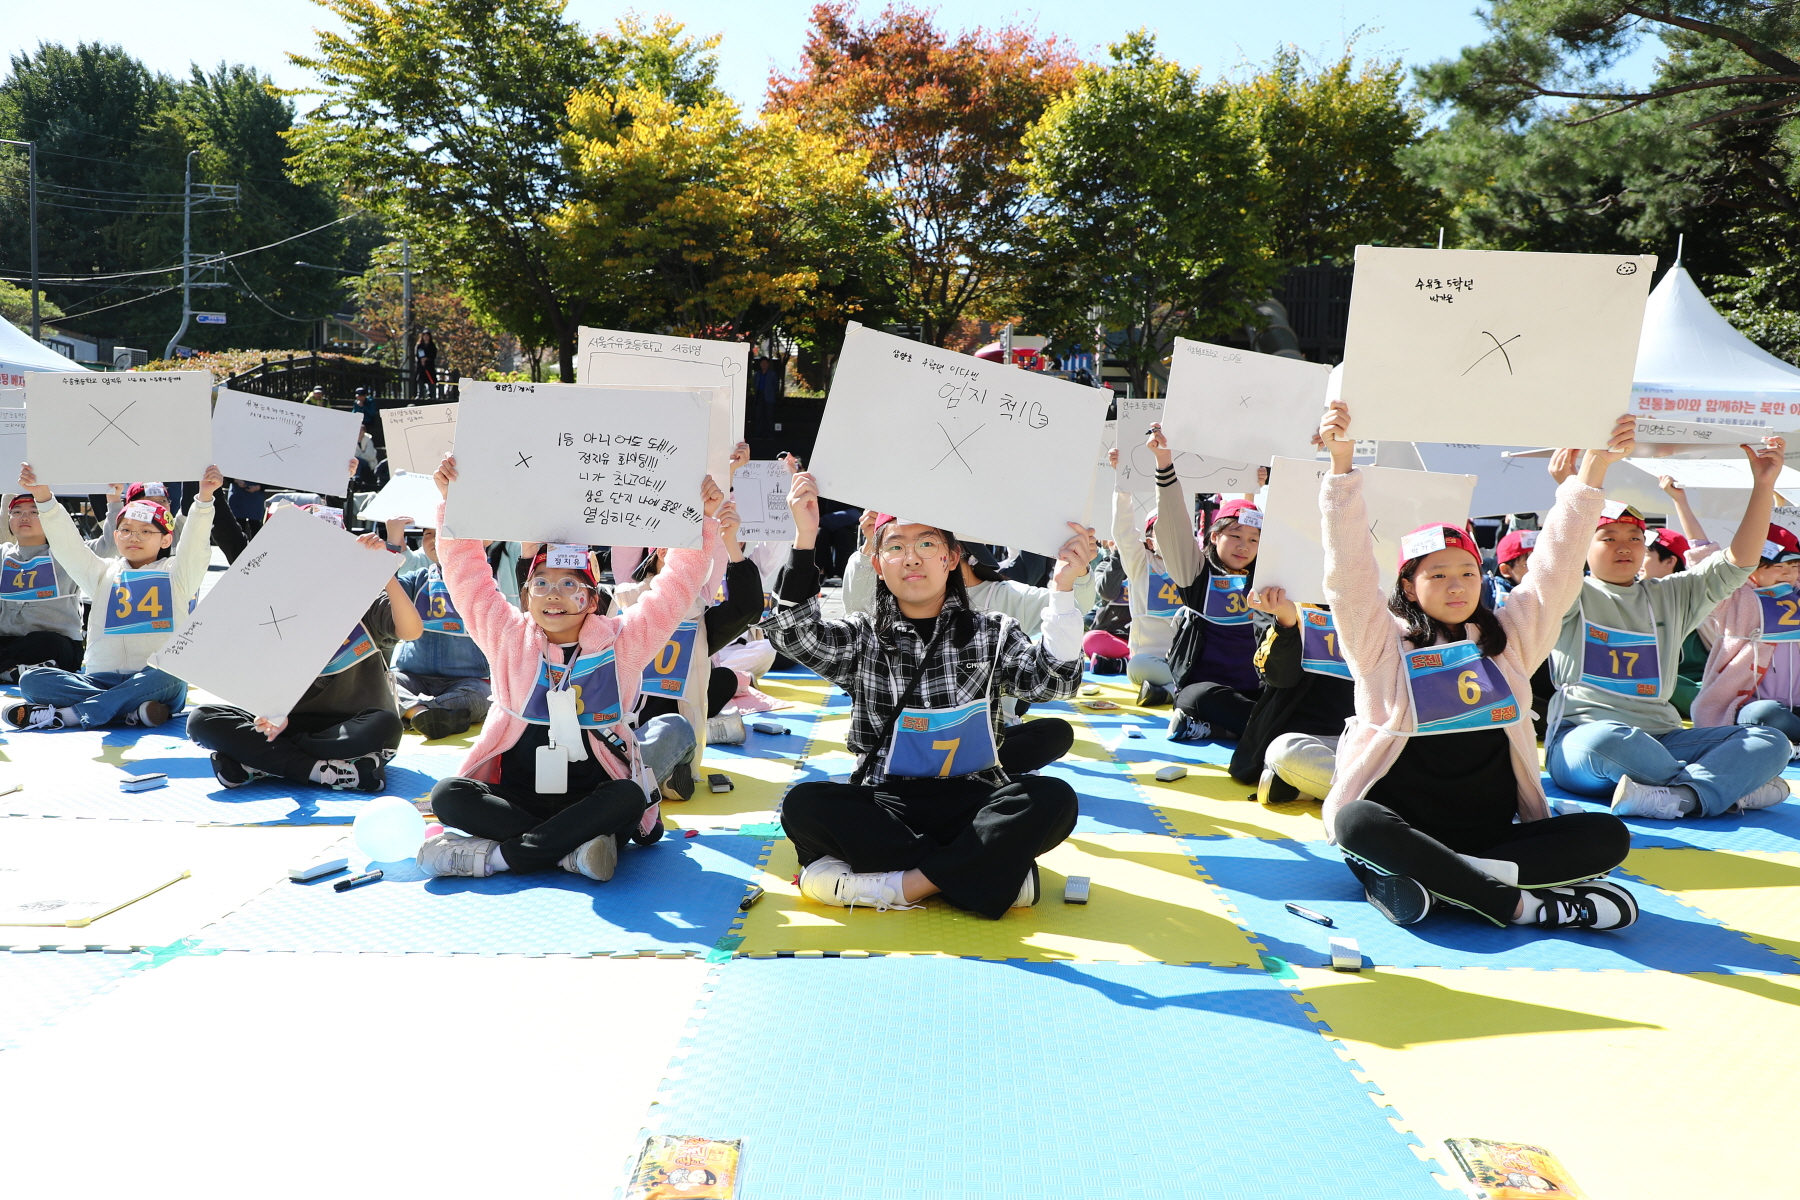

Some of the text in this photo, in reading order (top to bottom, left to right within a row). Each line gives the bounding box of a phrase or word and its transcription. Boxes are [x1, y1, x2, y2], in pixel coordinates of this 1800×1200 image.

[1414, 277, 1474, 292] 수유초 5학년
[587, 335, 702, 356] 서울수유초등학교 서하영
[938, 381, 1028, 424] 엄지 척!
[1638, 397, 1702, 411] 전통놀이와
[1706, 399, 1756, 414] 함께하는
[1760, 402, 1785, 415] 북한
[578, 451, 659, 473] 정지유 화이팅!!!
[554, 557, 581, 566] 정지유
[12, 570, 38, 589] 47
[115, 586, 163, 619] 34
[1411, 653, 1443, 669] 도전!
[1608, 649, 1640, 677] 17
[1457, 670, 1482, 705] 6
[1491, 705, 1517, 722] 열정!
[932, 737, 961, 777] 7
